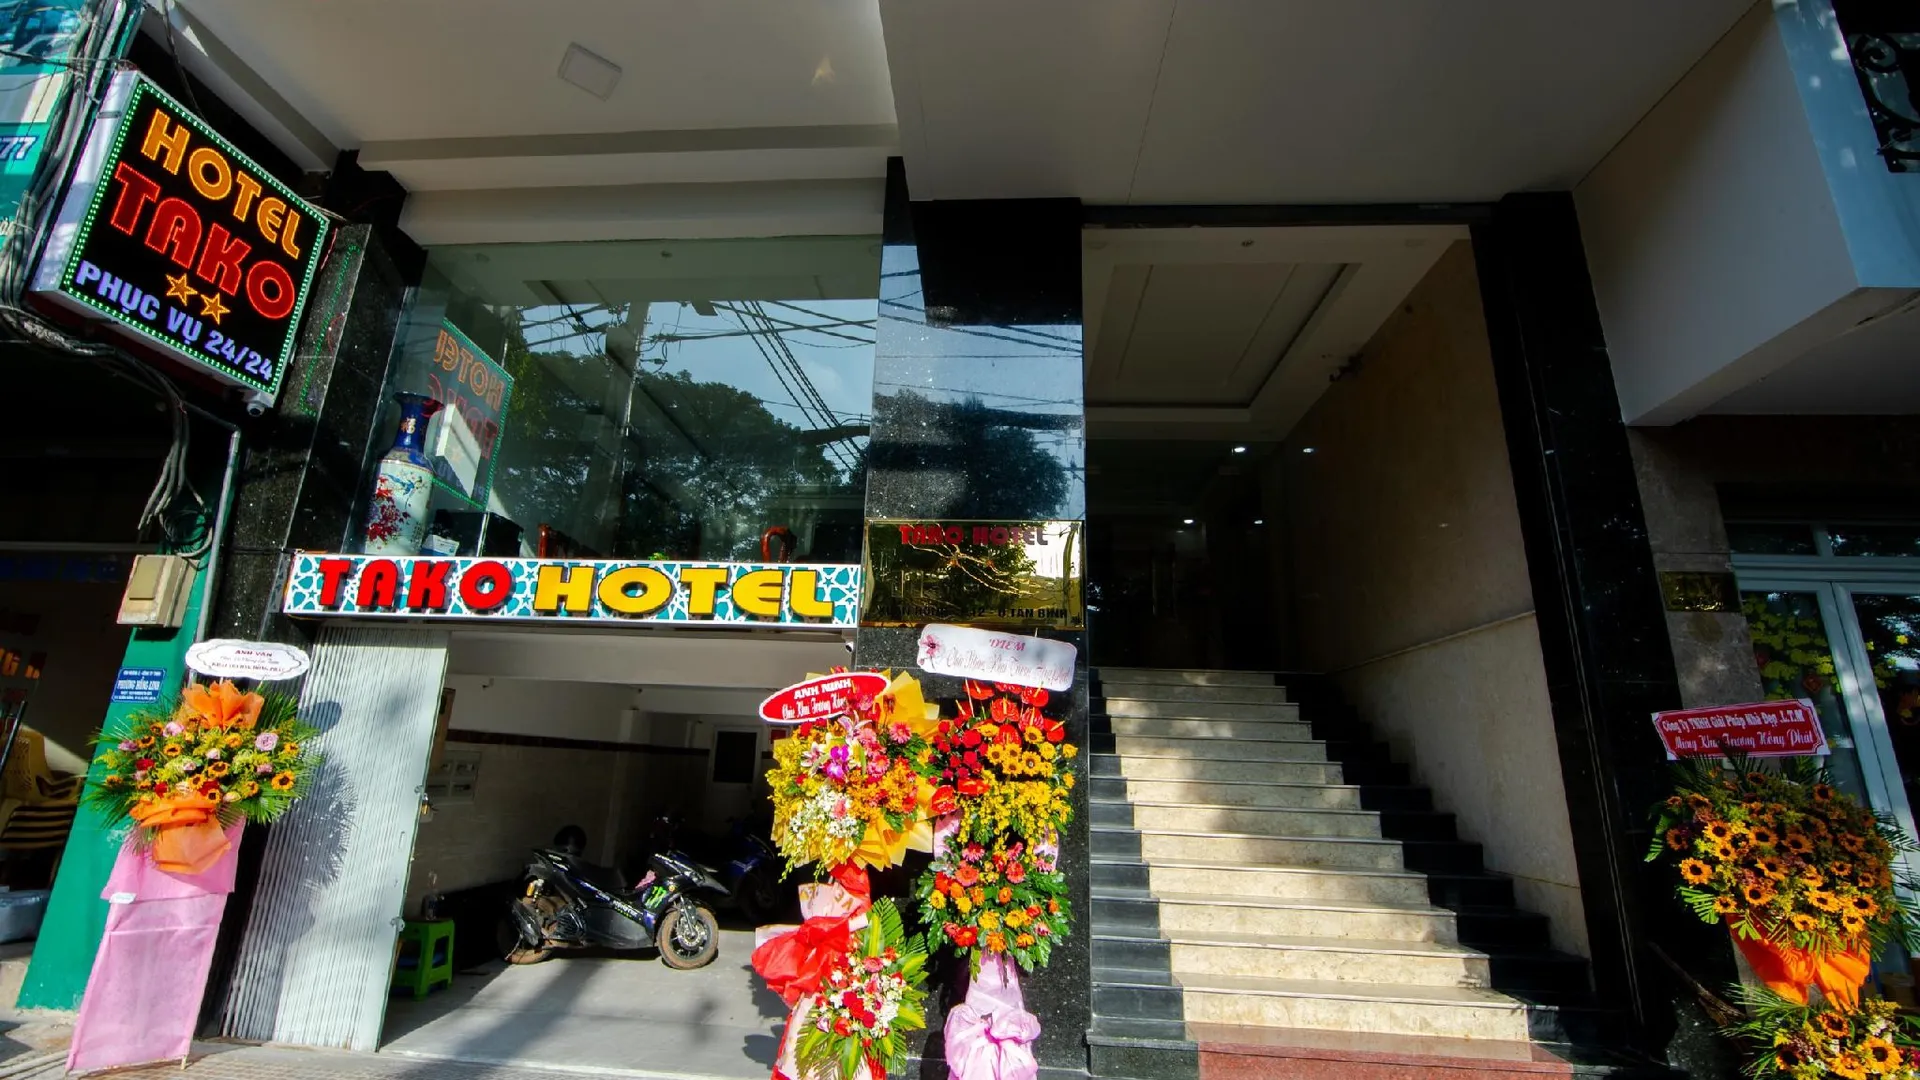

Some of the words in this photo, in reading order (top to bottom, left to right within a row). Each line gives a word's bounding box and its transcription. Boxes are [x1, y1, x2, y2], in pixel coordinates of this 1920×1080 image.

[141, 108, 300, 259] HOTEL
[110, 161, 296, 319] TAKO
[75, 260, 161, 321] PHỤC
[166, 305, 201, 346] VỤ
[204, 330, 273, 381] 24/24
[899, 525, 964, 545] TAKO
[972, 526, 1048, 546] HOTEL
[317, 558, 514, 610] TAKO
[532, 564, 836, 619] HOTEL
[794, 686, 819, 699] ANH
[821, 678, 852, 693] NINH
[1688, 717, 1711, 730] TNHH
